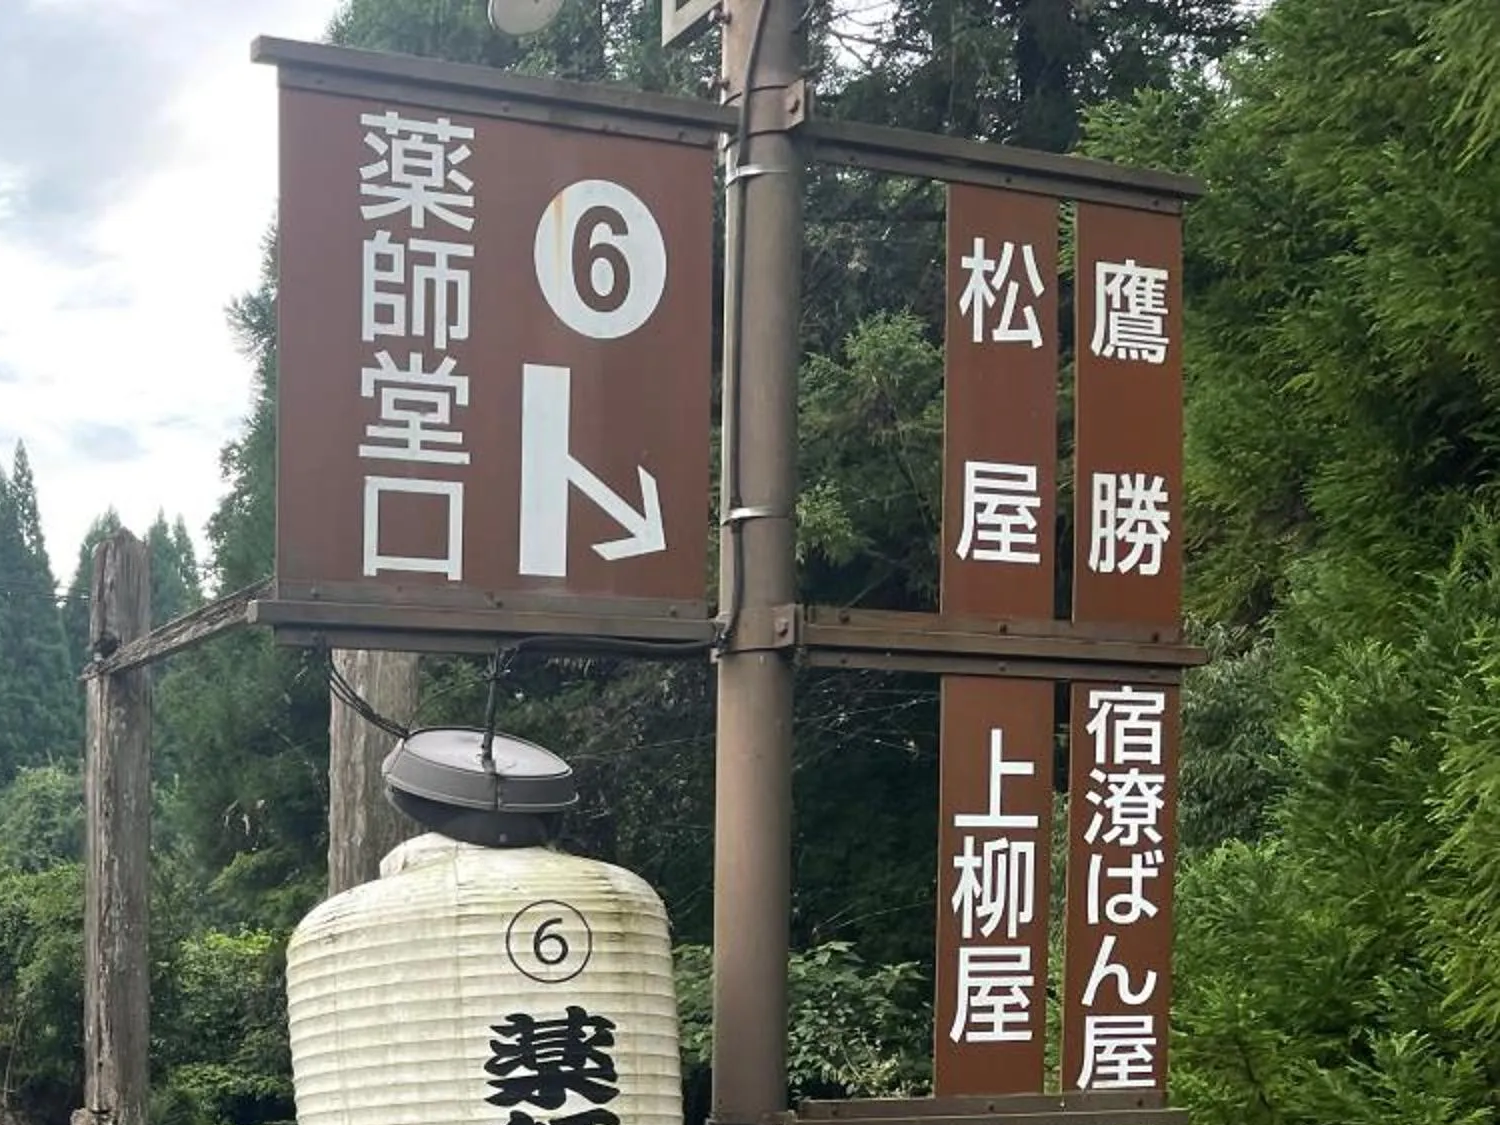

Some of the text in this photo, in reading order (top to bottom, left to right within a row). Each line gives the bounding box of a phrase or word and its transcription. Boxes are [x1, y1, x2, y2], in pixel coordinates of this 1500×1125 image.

[358, 111, 475, 581] 薬師堂口
[955, 237, 1045, 565] 松屋
[1088, 259, 1171, 577] 鷹勝
[949, 728, 1040, 1044] 上柳屋
